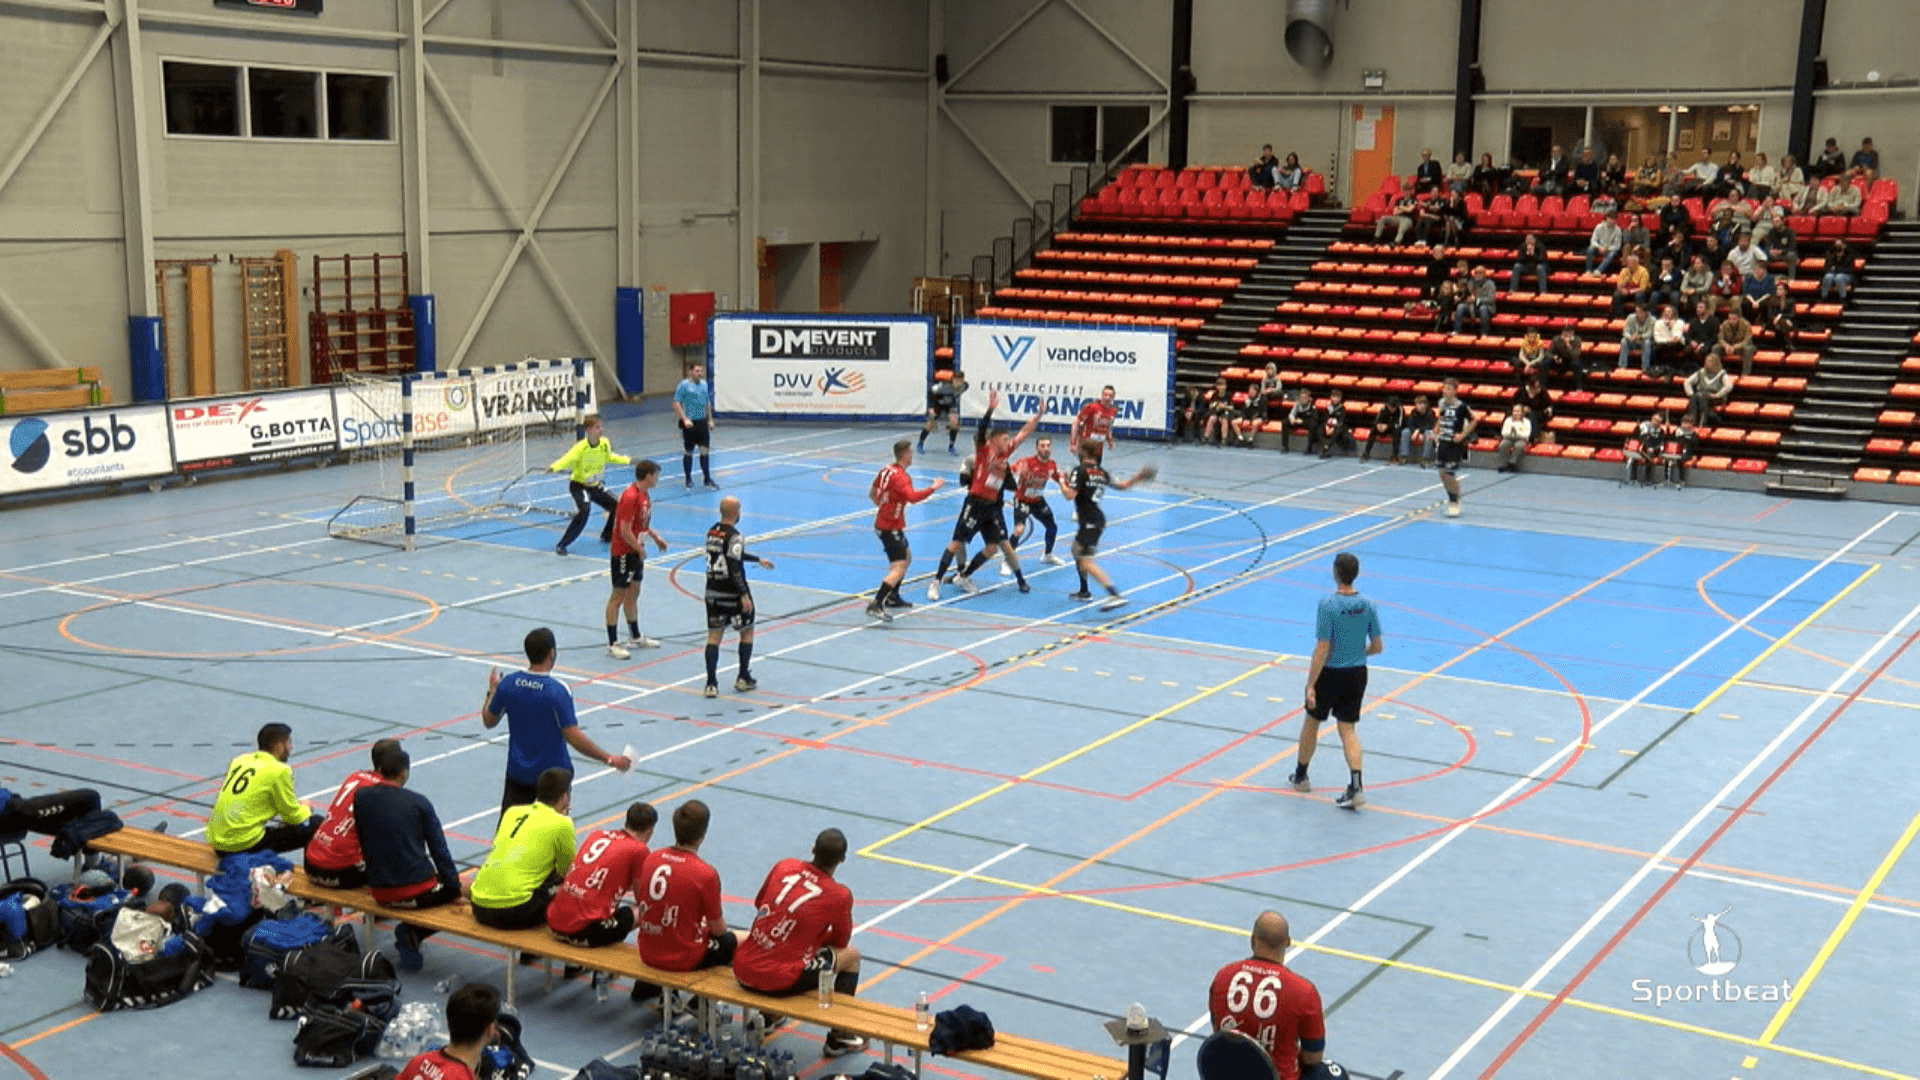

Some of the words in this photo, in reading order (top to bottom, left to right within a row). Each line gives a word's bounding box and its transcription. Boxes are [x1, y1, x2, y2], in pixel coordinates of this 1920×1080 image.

[759, 328, 811, 355] DM
[811, 329, 877, 347] EVENT
[811, 346, 877, 357] products
[1046, 346, 1137, 365] vandebos
[773, 373, 813, 389] DVV
[980, 380, 1084, 396] ELEKTRICITEIT
[174, 397, 268, 424] DEX
[1008, 393, 1145, 420] VRANEN
[62, 413, 136, 457] sbb
[250, 417, 332, 440] G.BOTTA
[515, 677, 544, 691] COACH
[222, 764, 256, 795] 16
[510, 813, 529, 839] 1
[582, 837, 612, 865] 9
[649, 863, 672, 901] 6
[774, 873, 823, 914] 17
[1226, 971, 1282, 1019] 66
